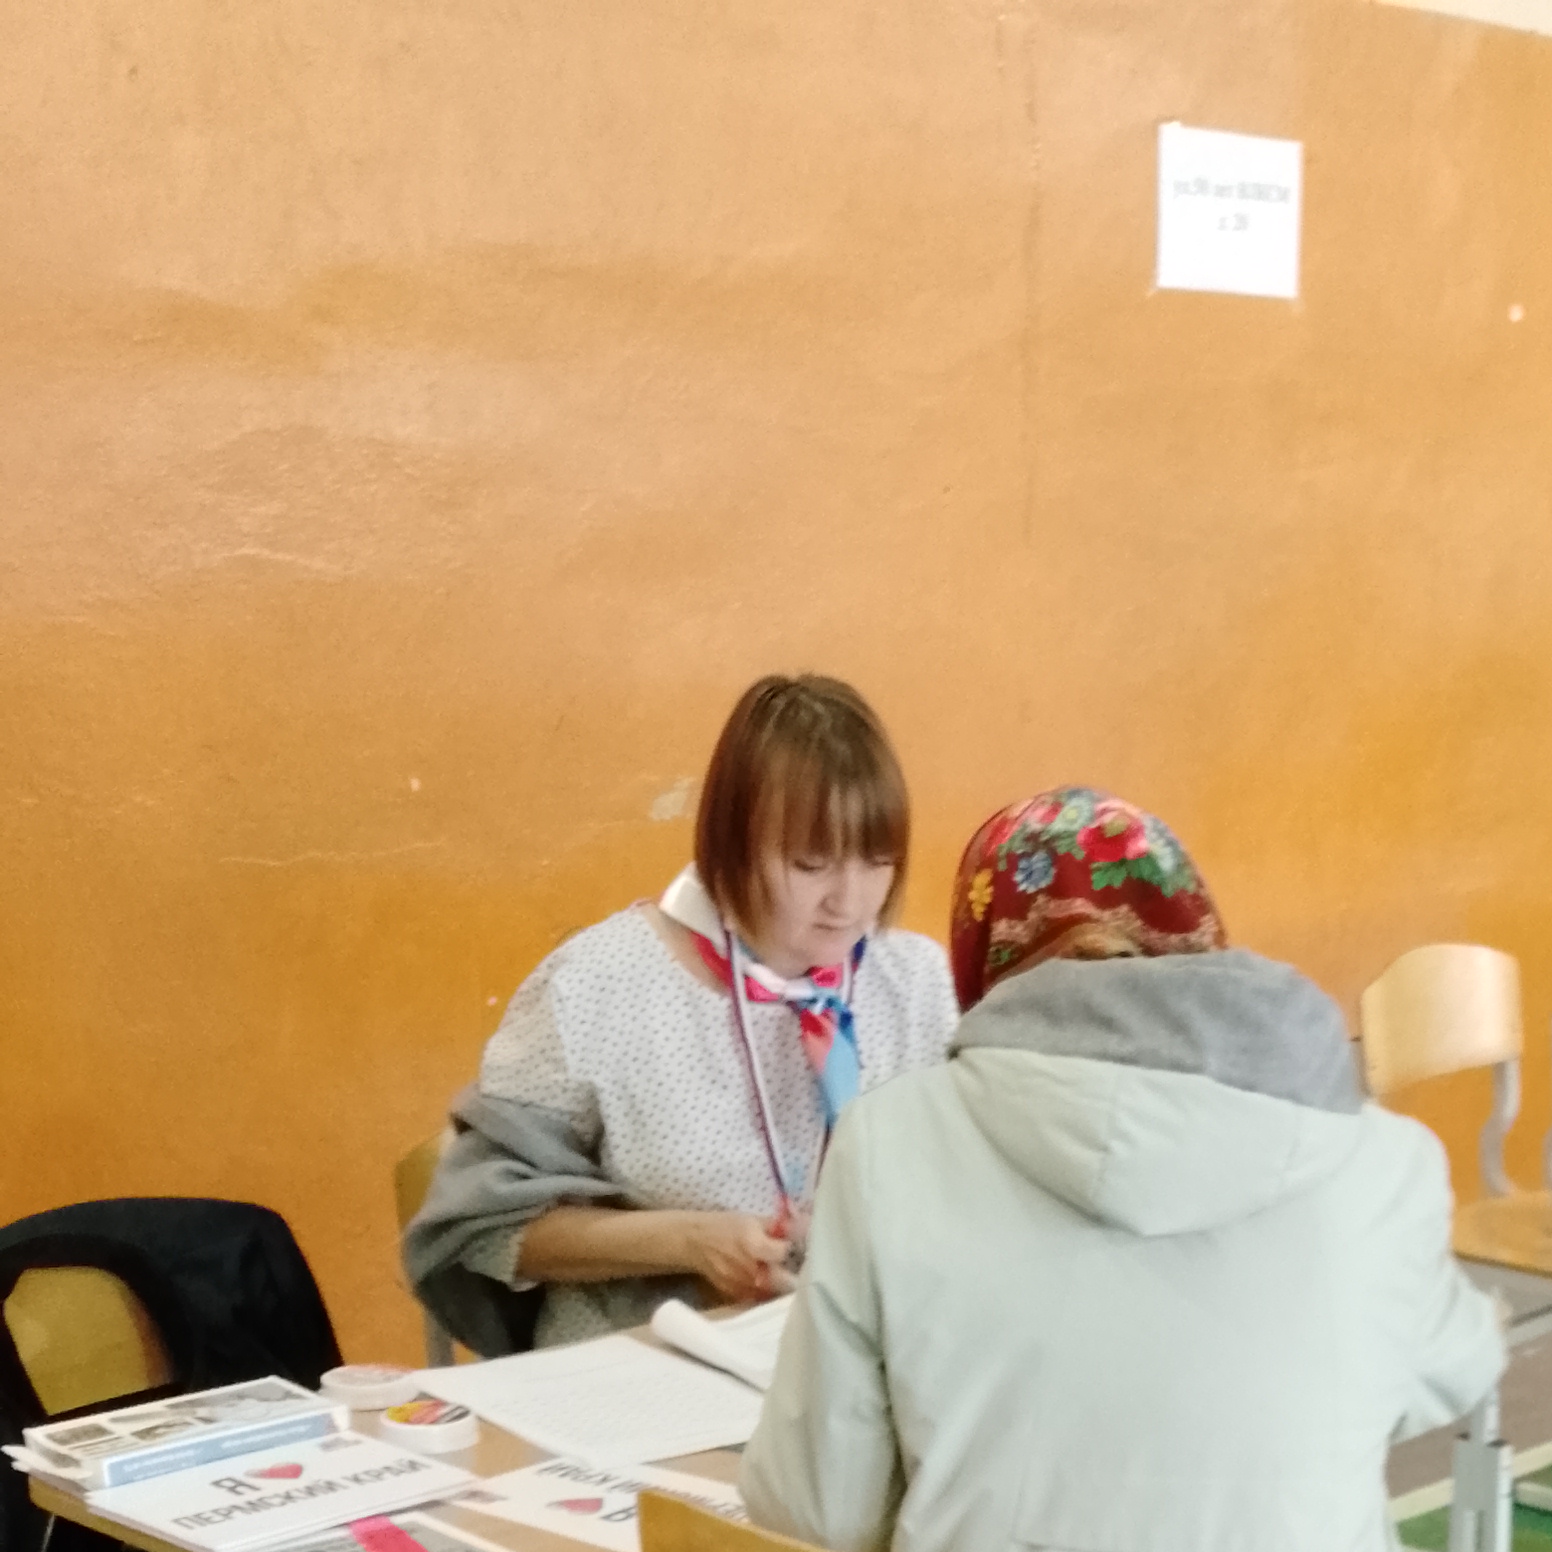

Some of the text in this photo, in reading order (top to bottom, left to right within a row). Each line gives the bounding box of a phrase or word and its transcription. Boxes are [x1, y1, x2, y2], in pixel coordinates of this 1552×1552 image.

[172, 1458, 431, 1530] ПЕРМСКИЙ КРАЙ
[211, 1477, 260, 1496] Я
